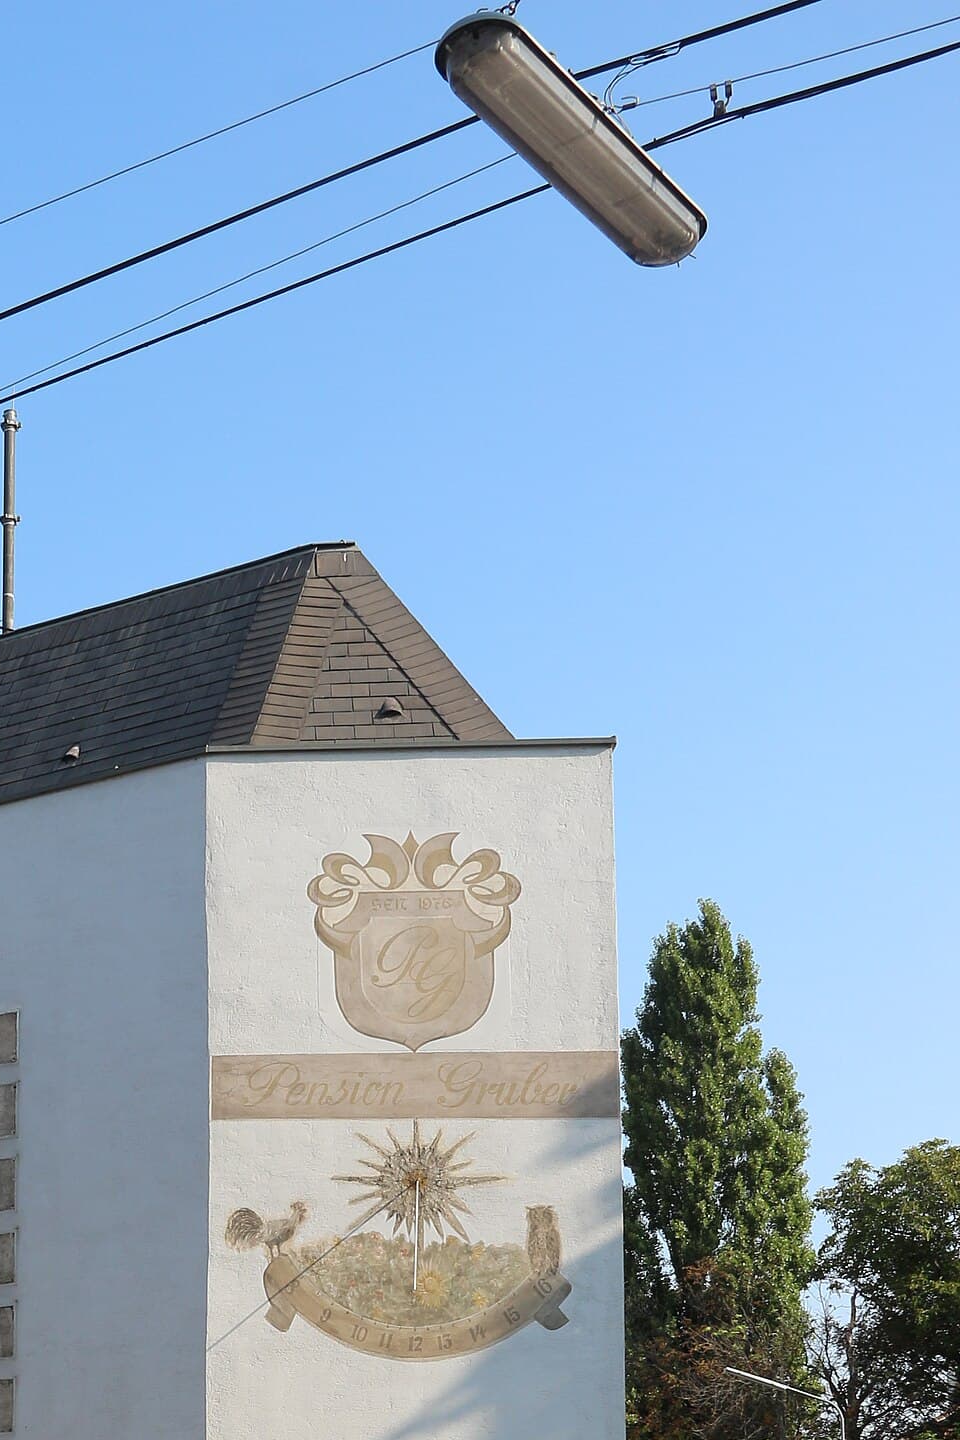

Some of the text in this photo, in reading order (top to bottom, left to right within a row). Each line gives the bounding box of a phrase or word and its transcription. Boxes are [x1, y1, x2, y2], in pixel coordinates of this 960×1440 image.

[243, 1060, 578, 1108] Pension Gruber
[352, 1323, 368, 1342] 10
[379, 1332, 394, 1350] 11
[408, 1335, 424, 1352] 12
[503, 1305, 522, 1325] 15
[534, 1277, 553, 1298] 16
